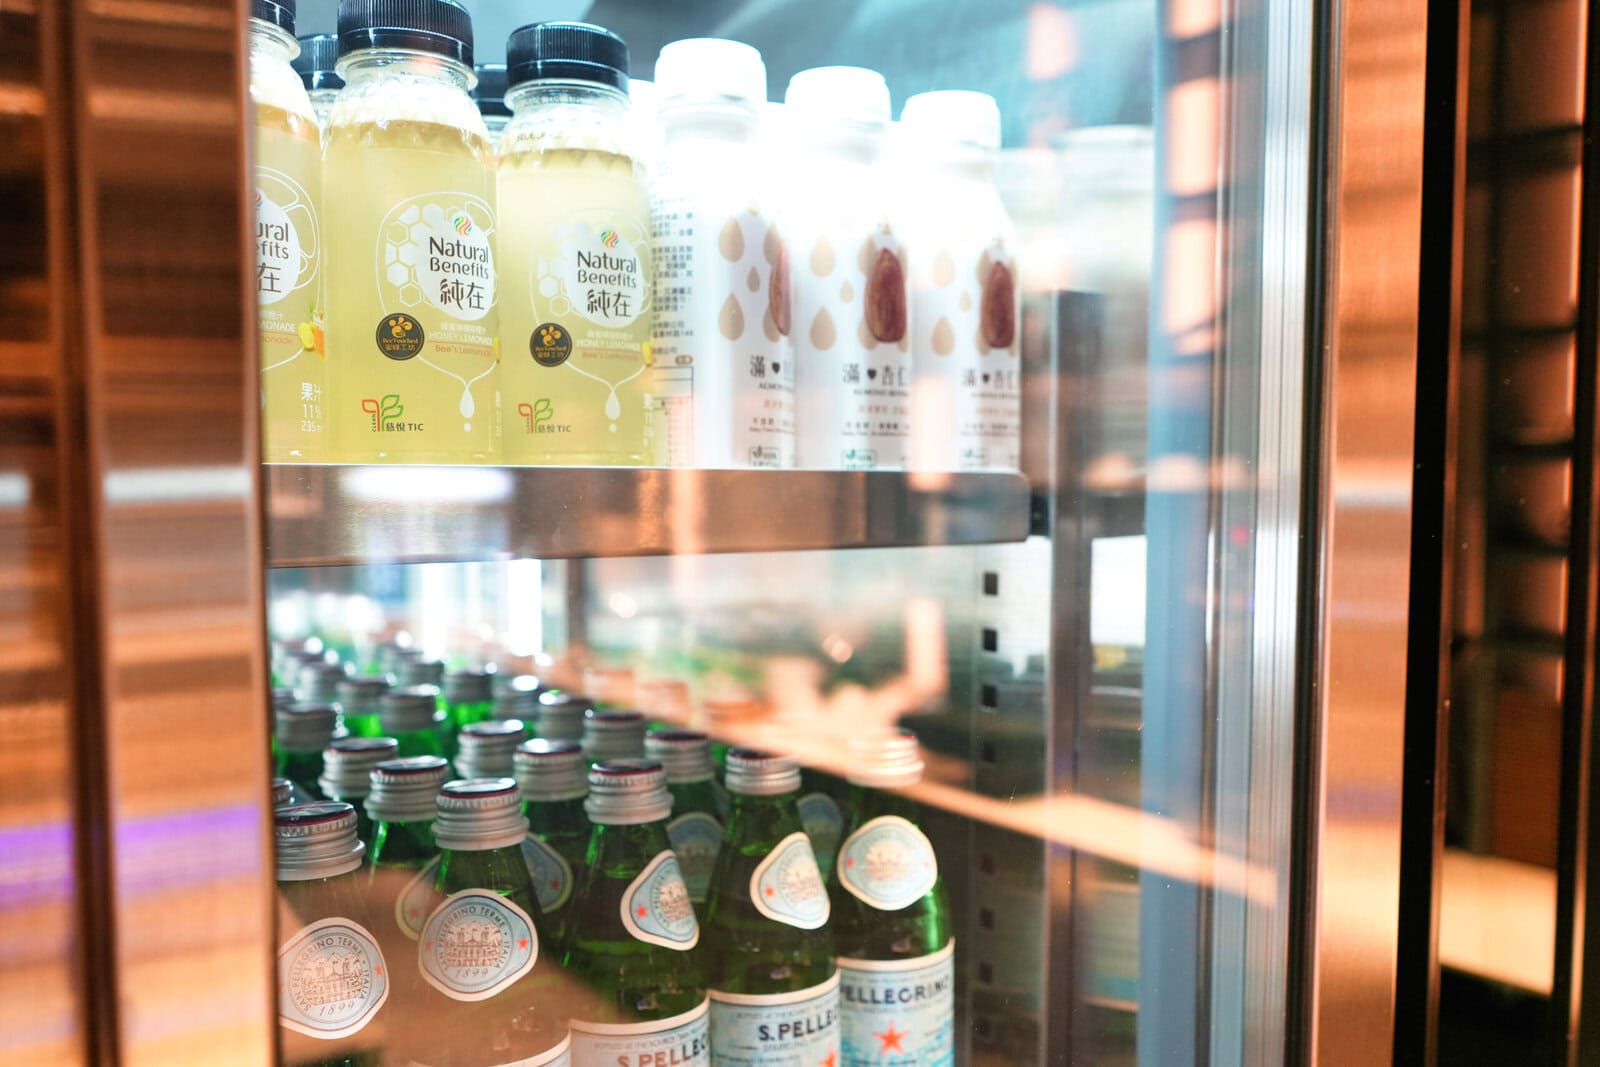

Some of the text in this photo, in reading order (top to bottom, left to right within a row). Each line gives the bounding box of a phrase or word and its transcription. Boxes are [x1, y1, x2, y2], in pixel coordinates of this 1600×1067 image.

[429, 236, 489, 262] Natural
[430, 257, 489, 280] Benefits
[576, 250, 637, 274] Natural
[577, 269, 637, 289] Benefits
[440, 278, 485, 310] 純在
[587, 288, 632, 319] 純在
[301, 382, 322, 401] 果汁
[407, 423, 425, 432] TIC
[480, 906, 506, 928] TERME
[494, 940, 511, 969] ITALIA
